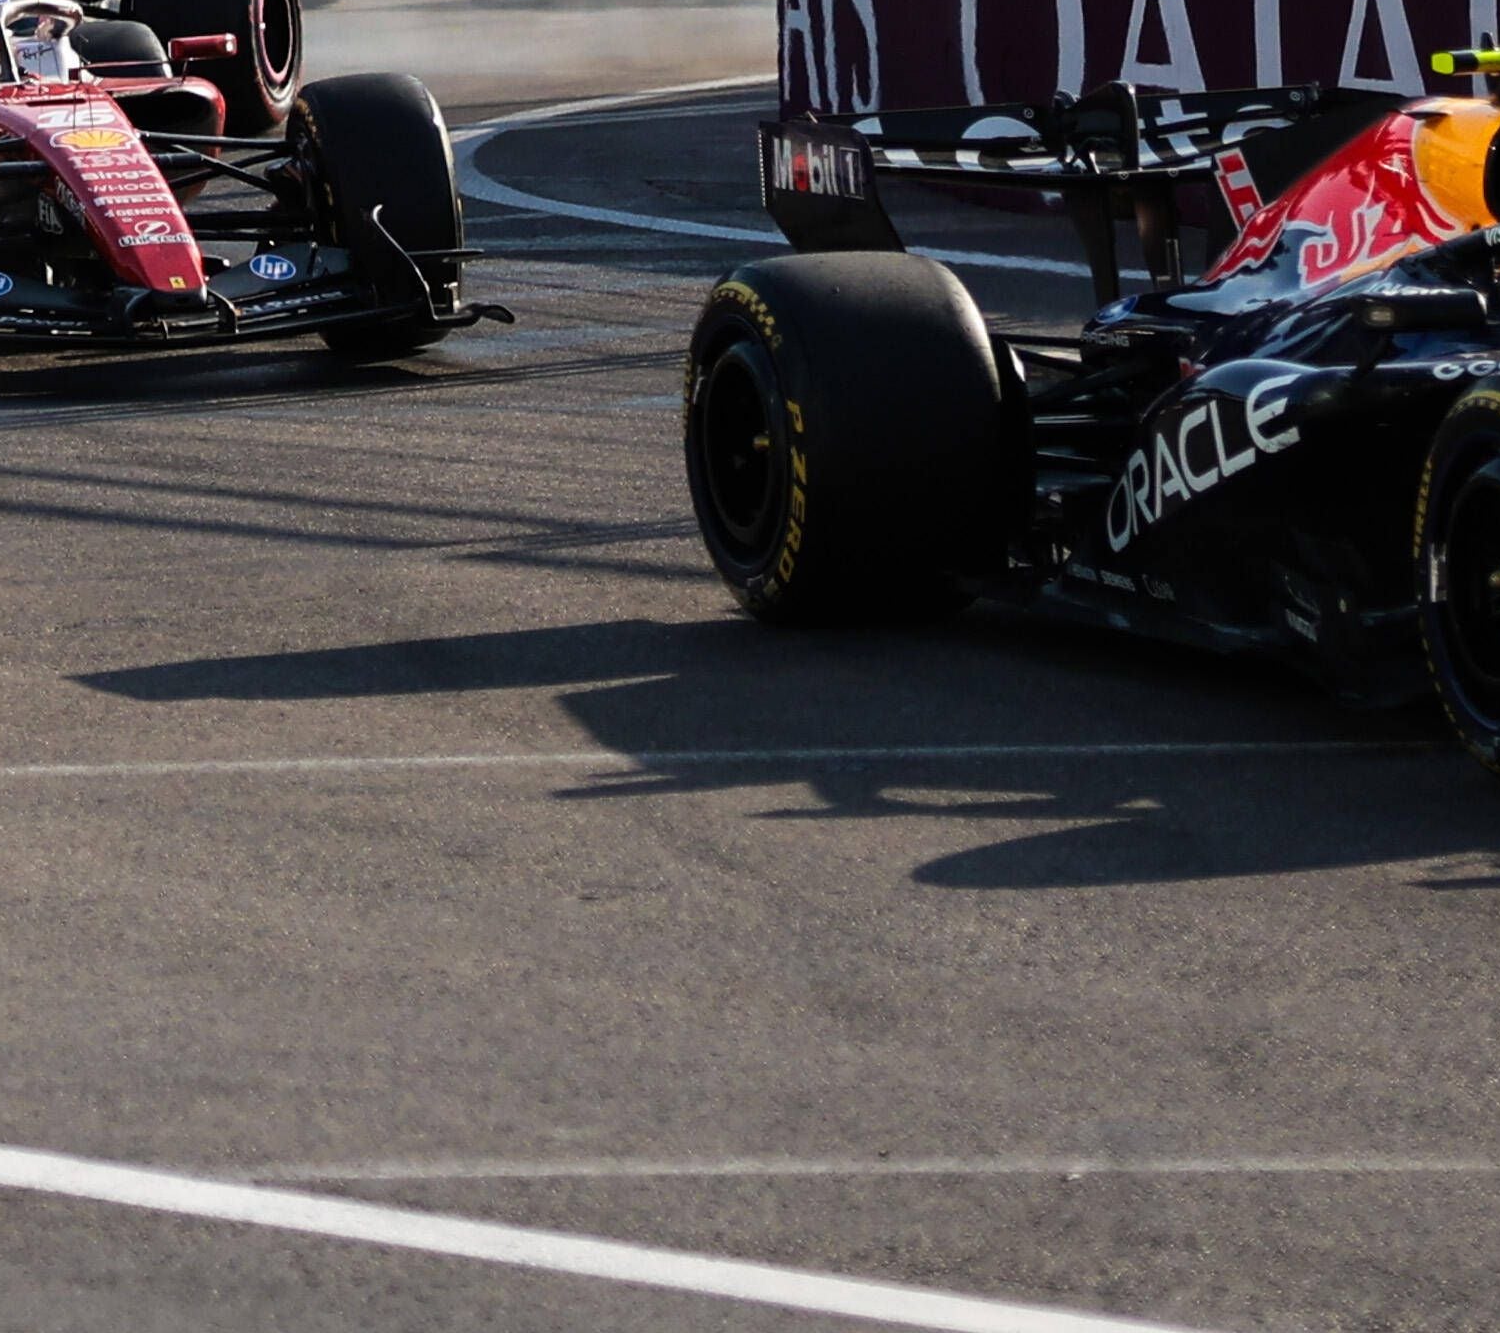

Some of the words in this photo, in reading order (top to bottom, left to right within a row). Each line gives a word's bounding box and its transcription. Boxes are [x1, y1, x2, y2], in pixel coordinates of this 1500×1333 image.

[36, 108, 116, 130] 16
[773, 136, 840, 195] Mobil
[256, 254, 291, 280] hp
[1106, 373, 1300, 553] ORACLE
